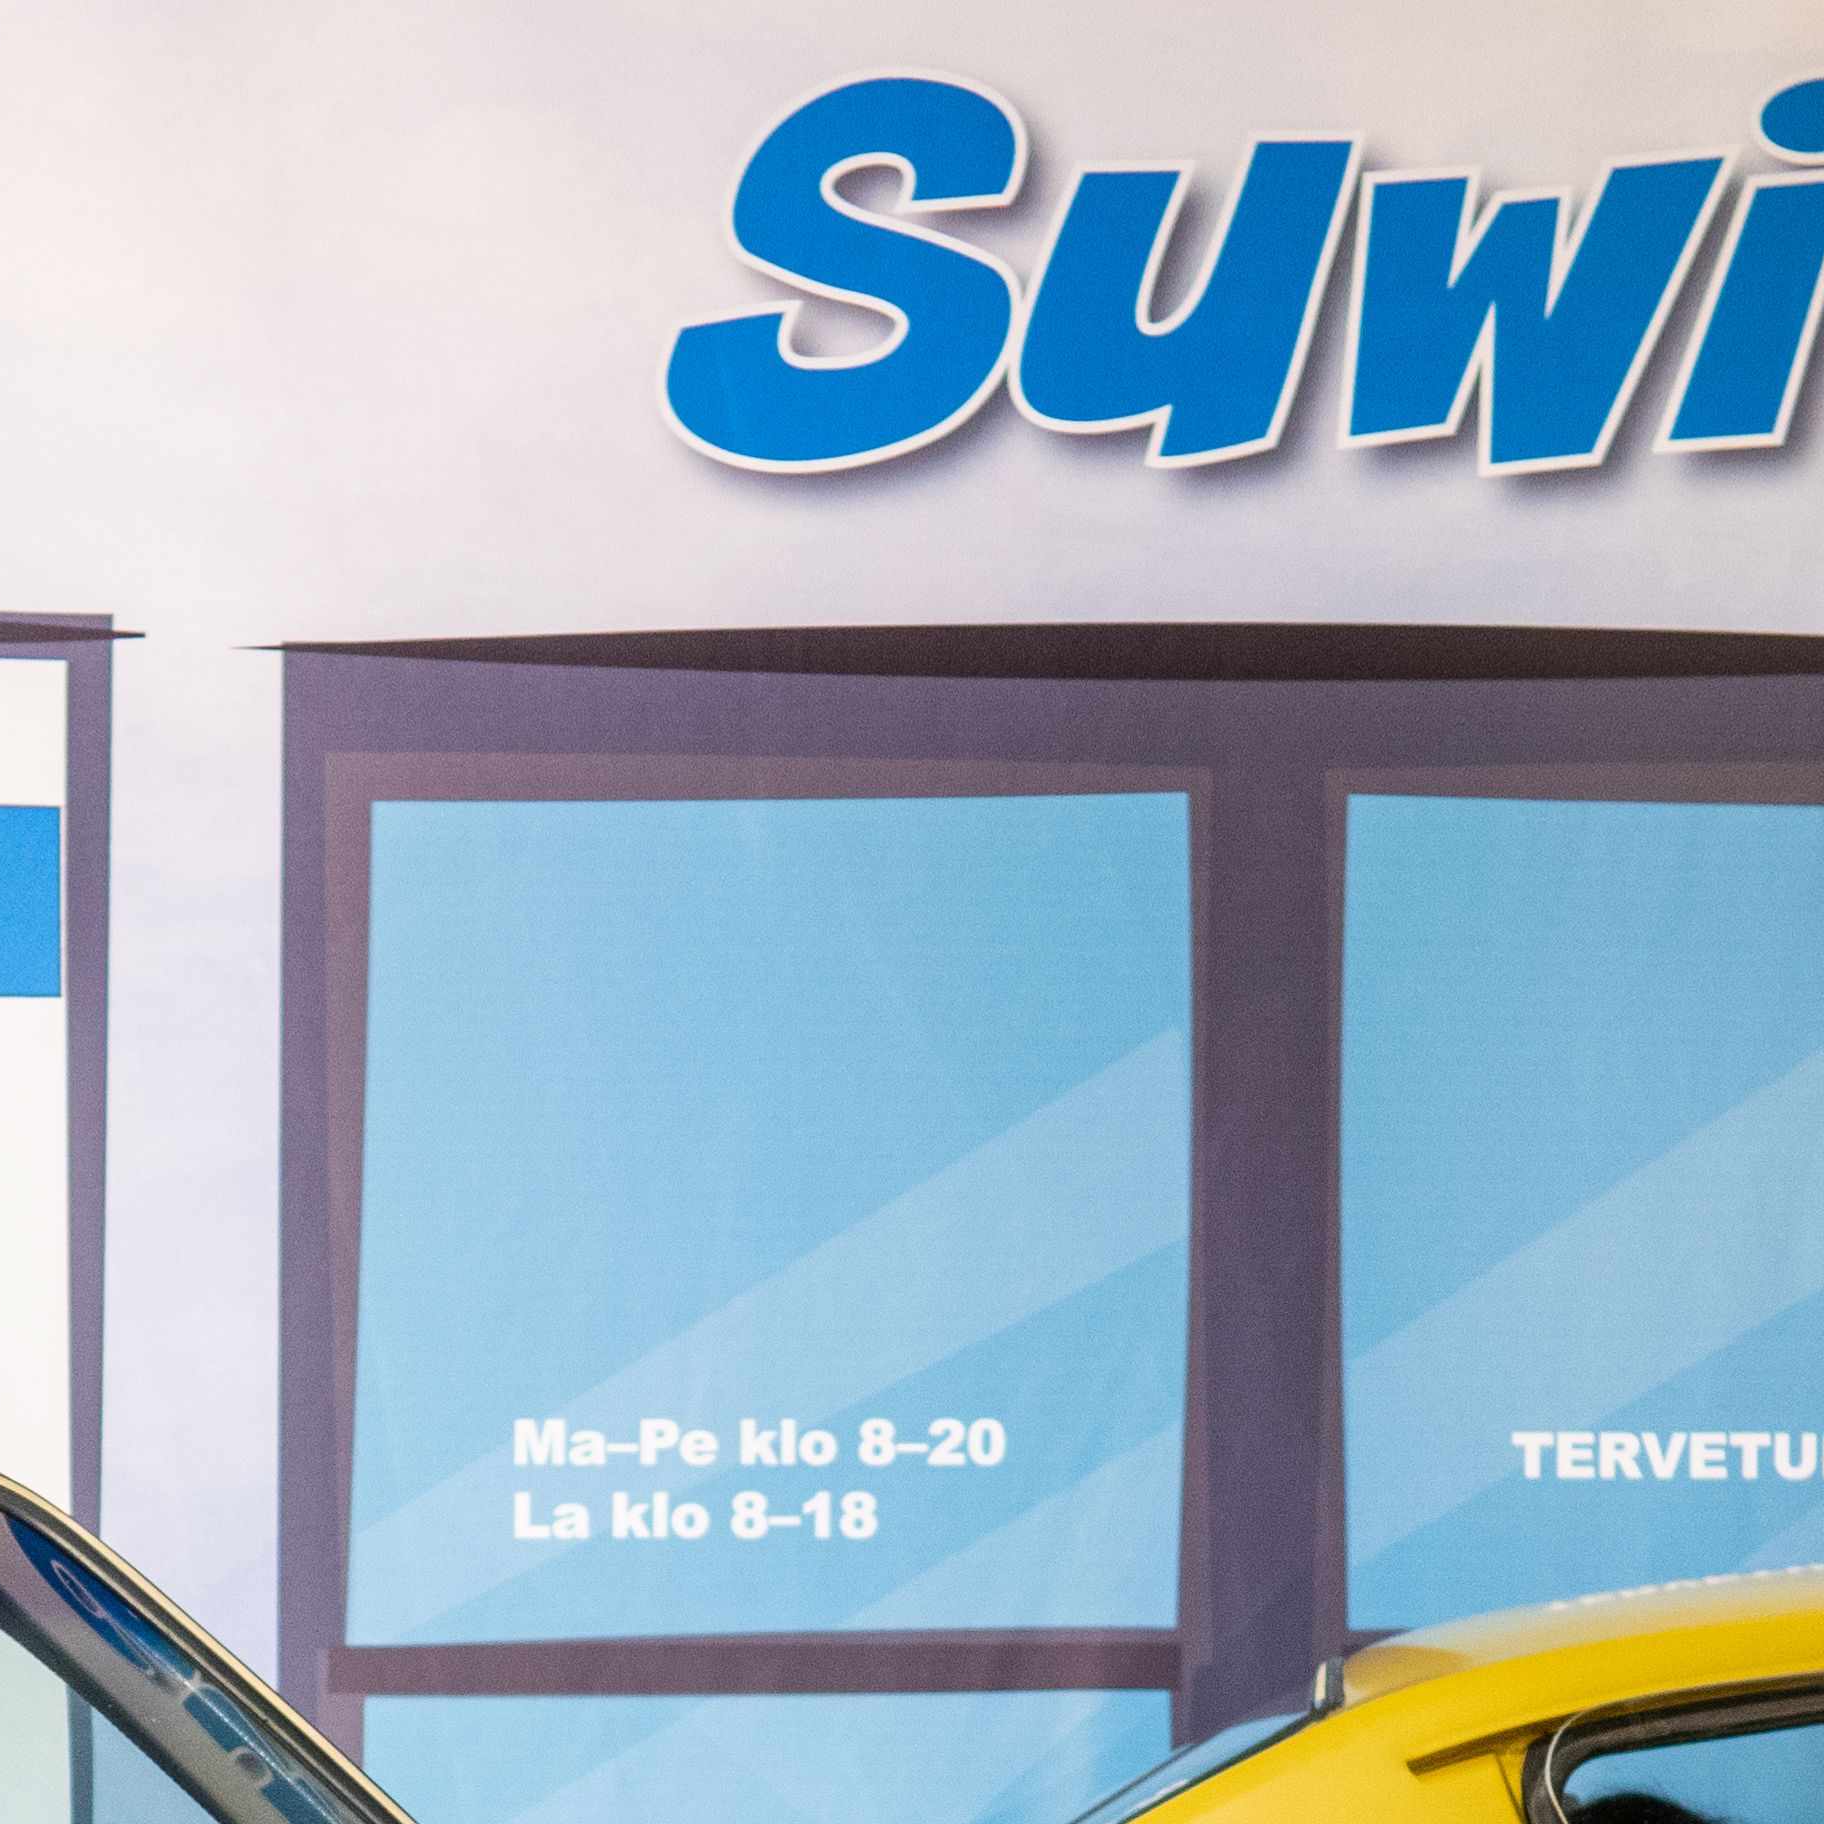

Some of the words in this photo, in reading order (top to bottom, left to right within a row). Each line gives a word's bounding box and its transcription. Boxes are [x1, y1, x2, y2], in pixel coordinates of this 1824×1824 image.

[739, 1418, 838, 1467] klo
[513, 1491, 590, 1539] La
[611, 1491, 711, 1539] klo
